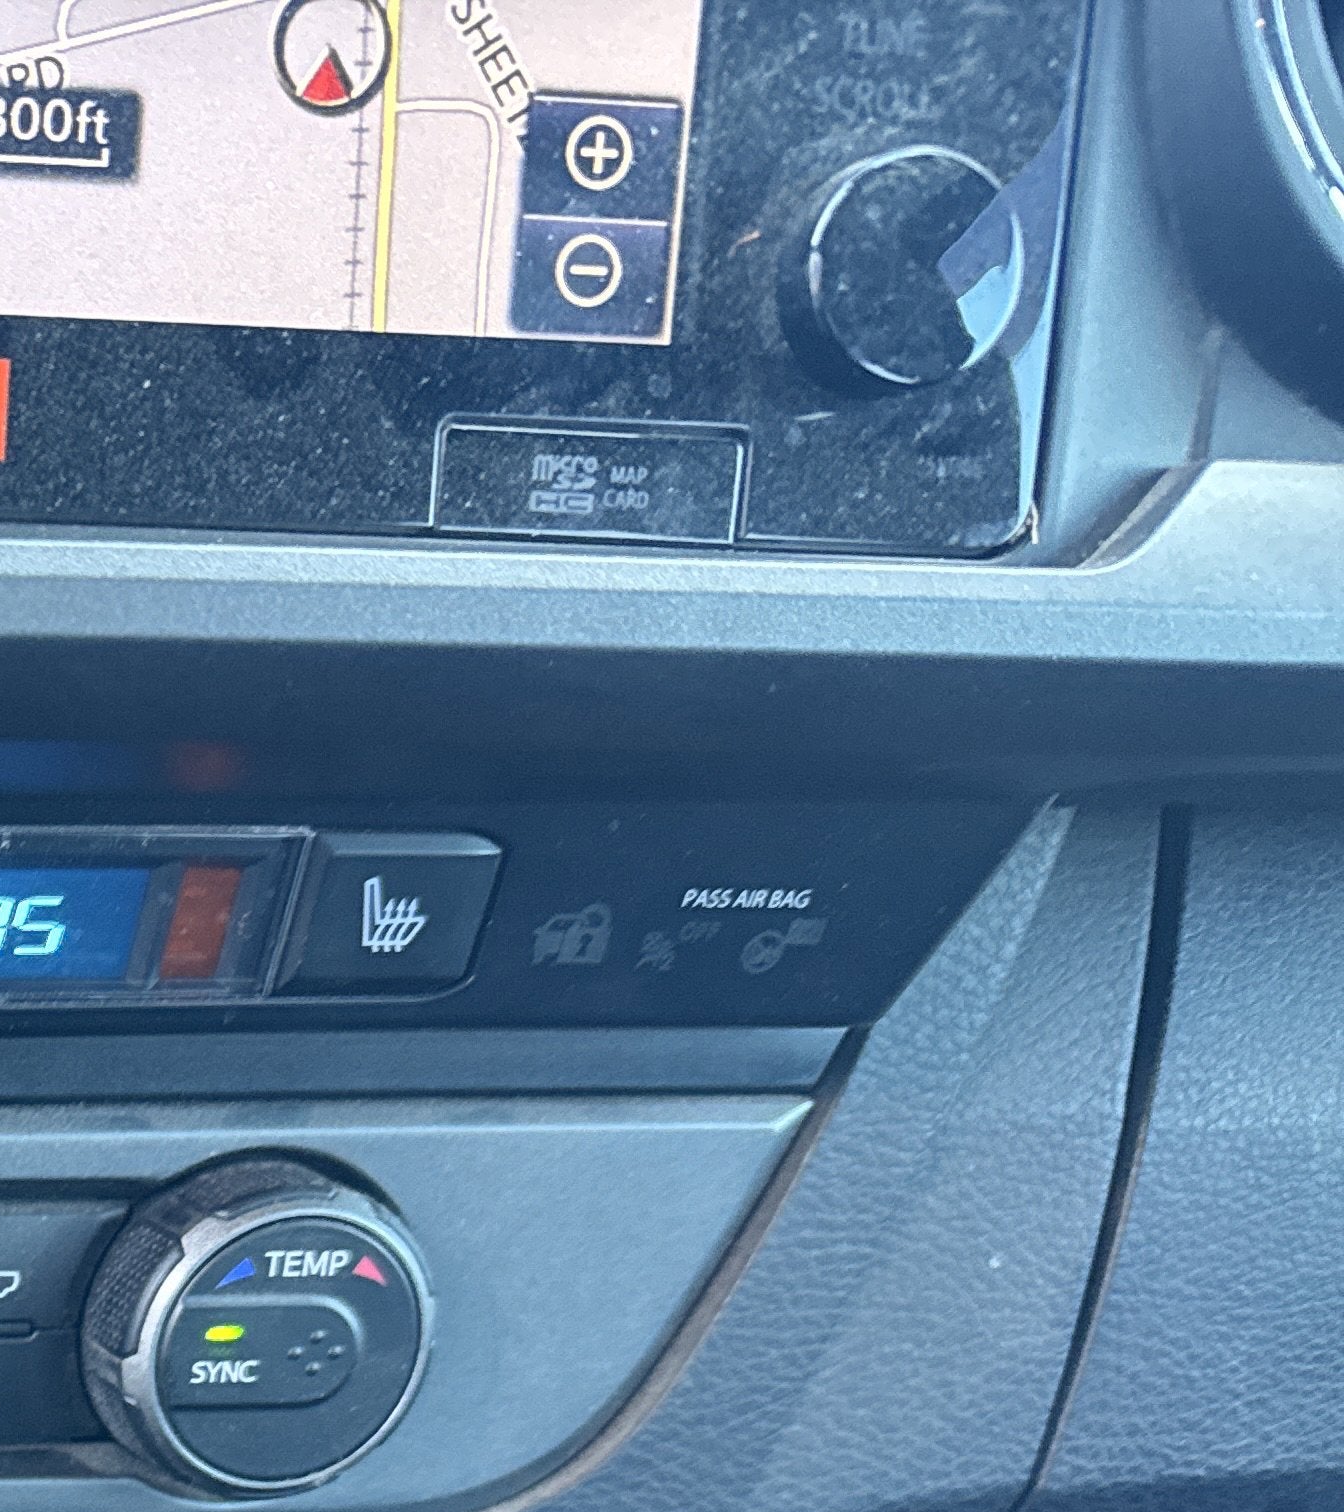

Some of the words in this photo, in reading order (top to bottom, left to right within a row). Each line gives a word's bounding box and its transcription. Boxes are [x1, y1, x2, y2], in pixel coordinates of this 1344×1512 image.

[610, 465, 649, 485] MAP
[602, 488, 650, 511] CARD
[680, 888, 734, 909] PASS
[732, 888, 767, 909] AIR
[768, 889, 812, 909] BAG
[263, 1249, 349, 1280] TEMP
[188, 1359, 261, 1386] SYNC
